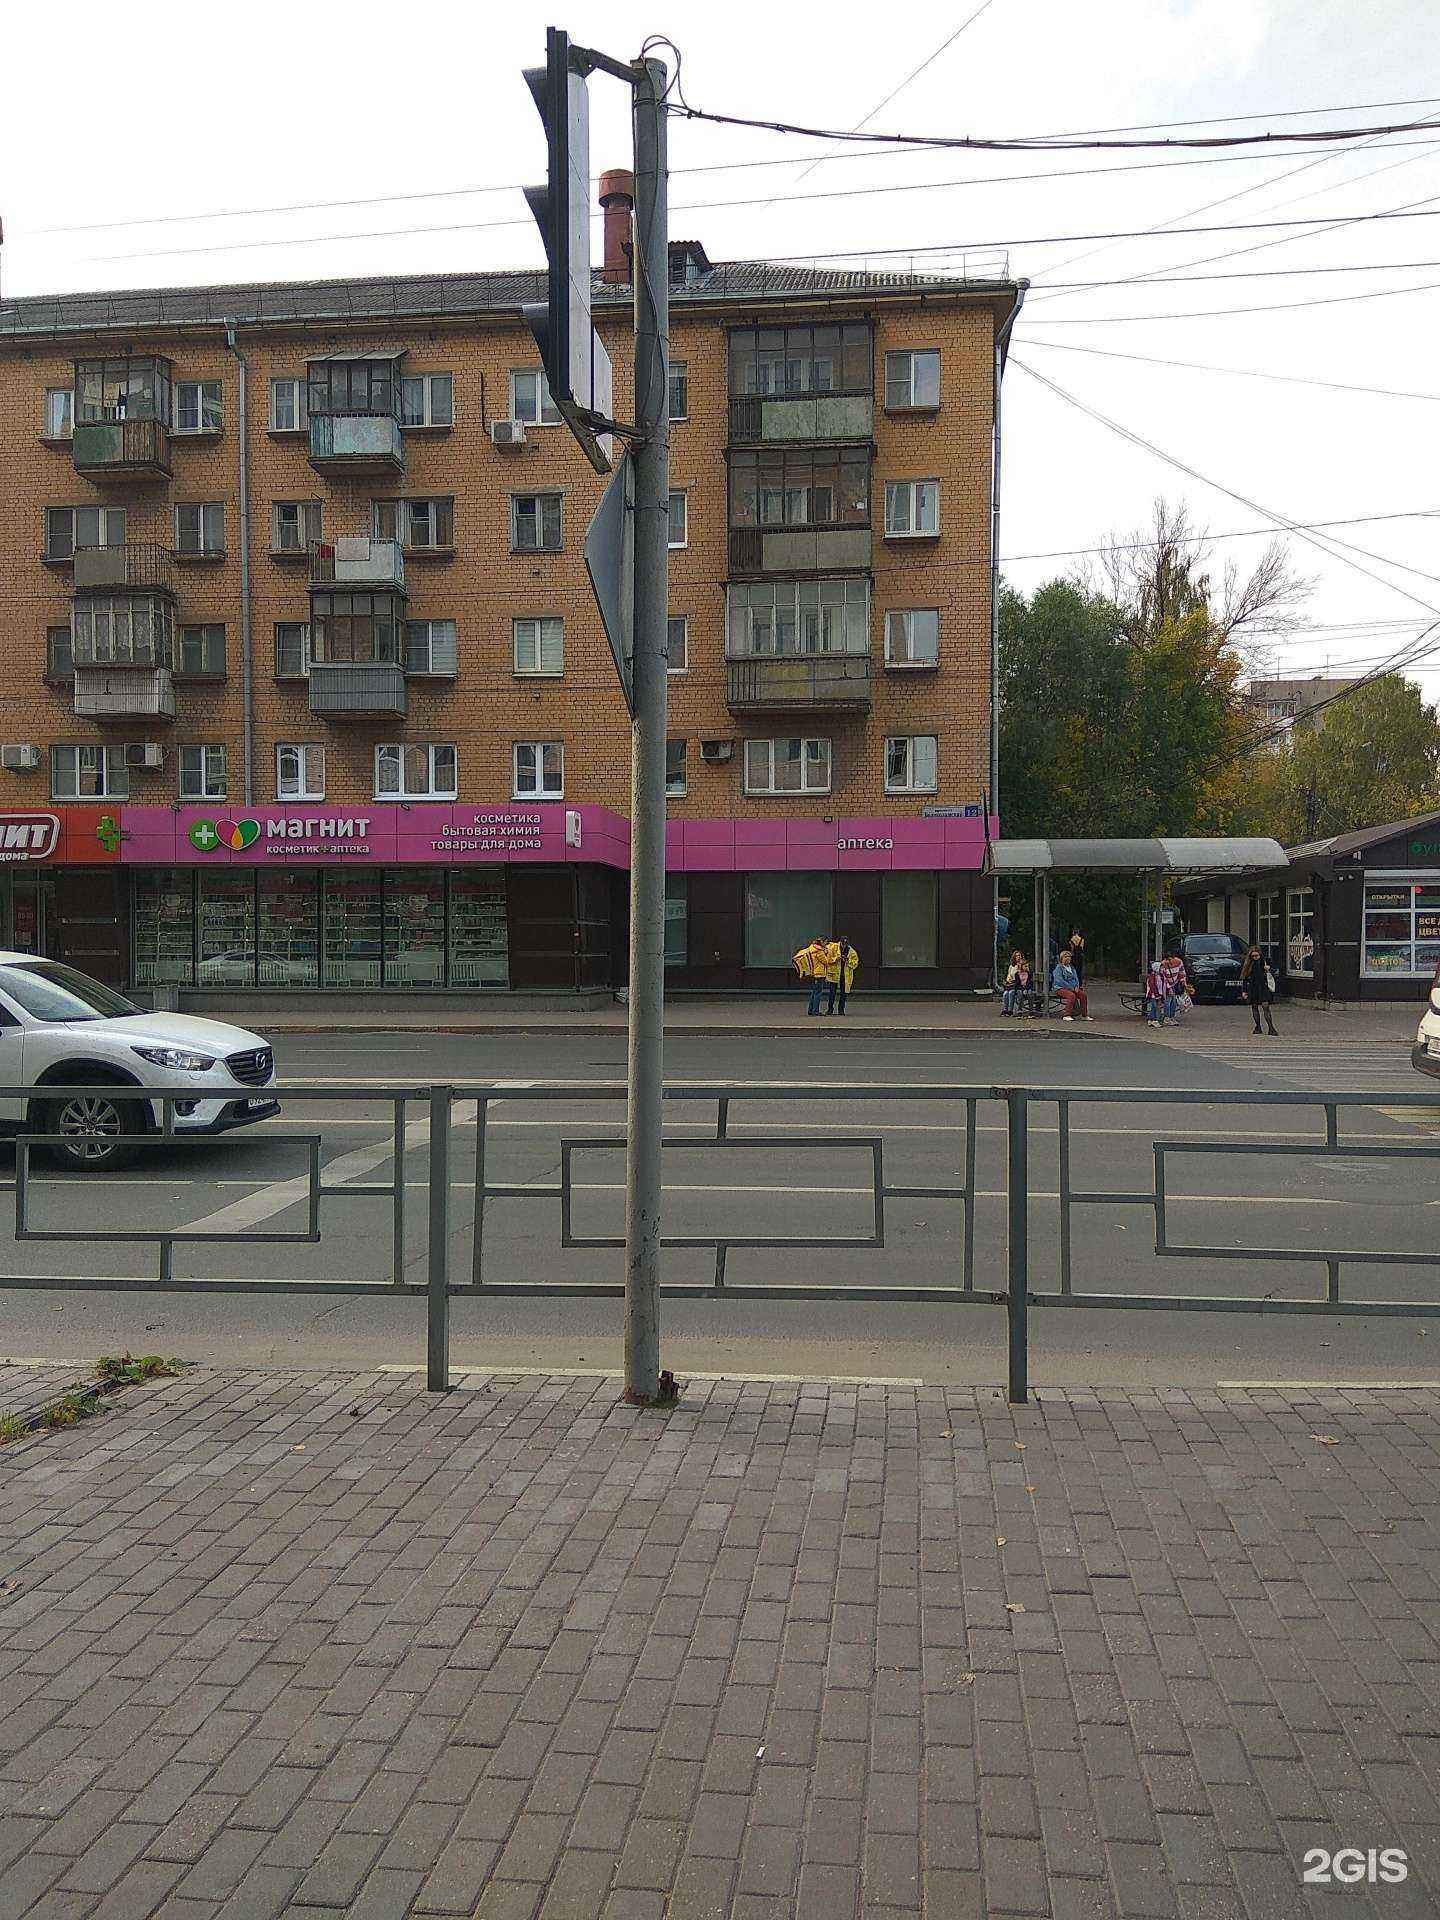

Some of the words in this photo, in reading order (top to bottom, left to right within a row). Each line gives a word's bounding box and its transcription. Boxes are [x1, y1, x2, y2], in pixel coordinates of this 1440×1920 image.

[473, 814, 541, 824] косметика
[267, 818, 370, 838] магнит
[442, 824, 497, 836] бытовая
[500, 826, 540, 835] химия
[0, 824, 49, 848] ИТ
[430, 839, 477, 852] товары
[480, 840, 505, 850] для
[508, 839, 541, 850] дома
[837, 838, 893, 850] аптека
[1418, 917, 1437, 925] ВСЕ
